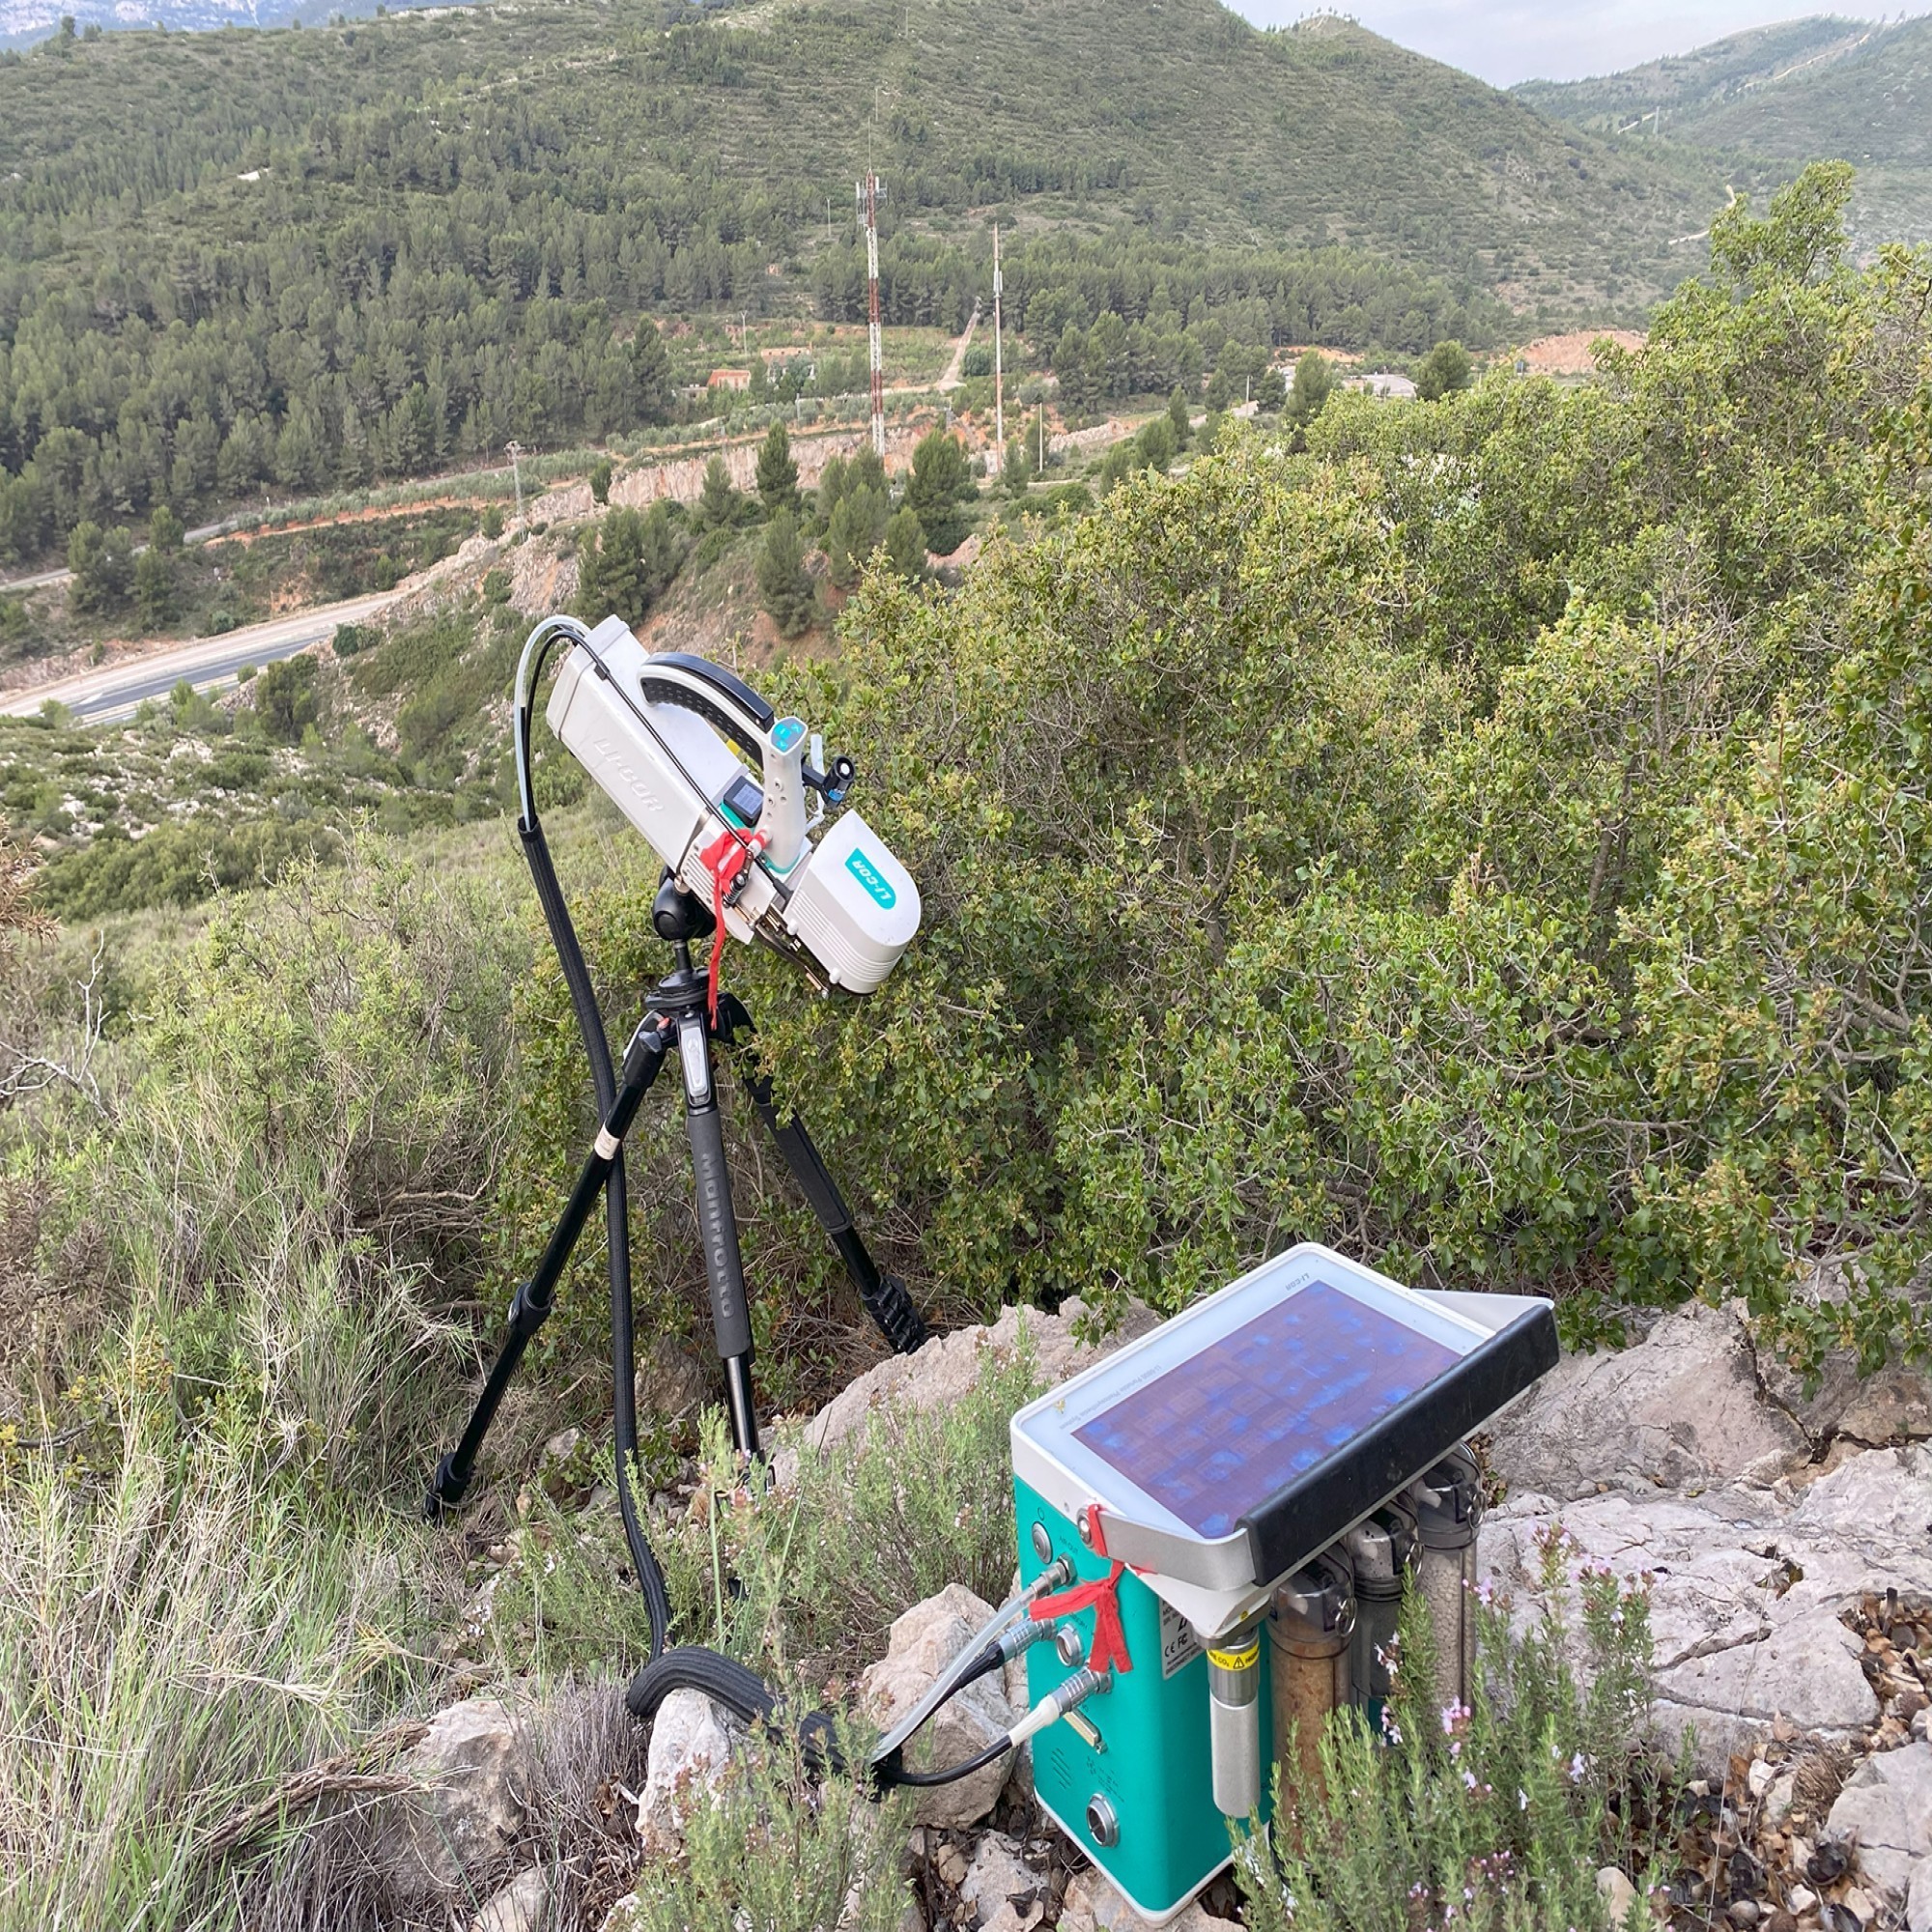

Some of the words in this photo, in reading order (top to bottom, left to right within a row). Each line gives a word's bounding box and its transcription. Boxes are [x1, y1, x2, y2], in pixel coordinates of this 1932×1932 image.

[593, 738, 665, 811] LI-COR
[851, 860, 893, 900] LI-COR
[701, 1152, 735, 1320] Manfrotto
[1285, 1272, 1310, 1292] LI-COR
